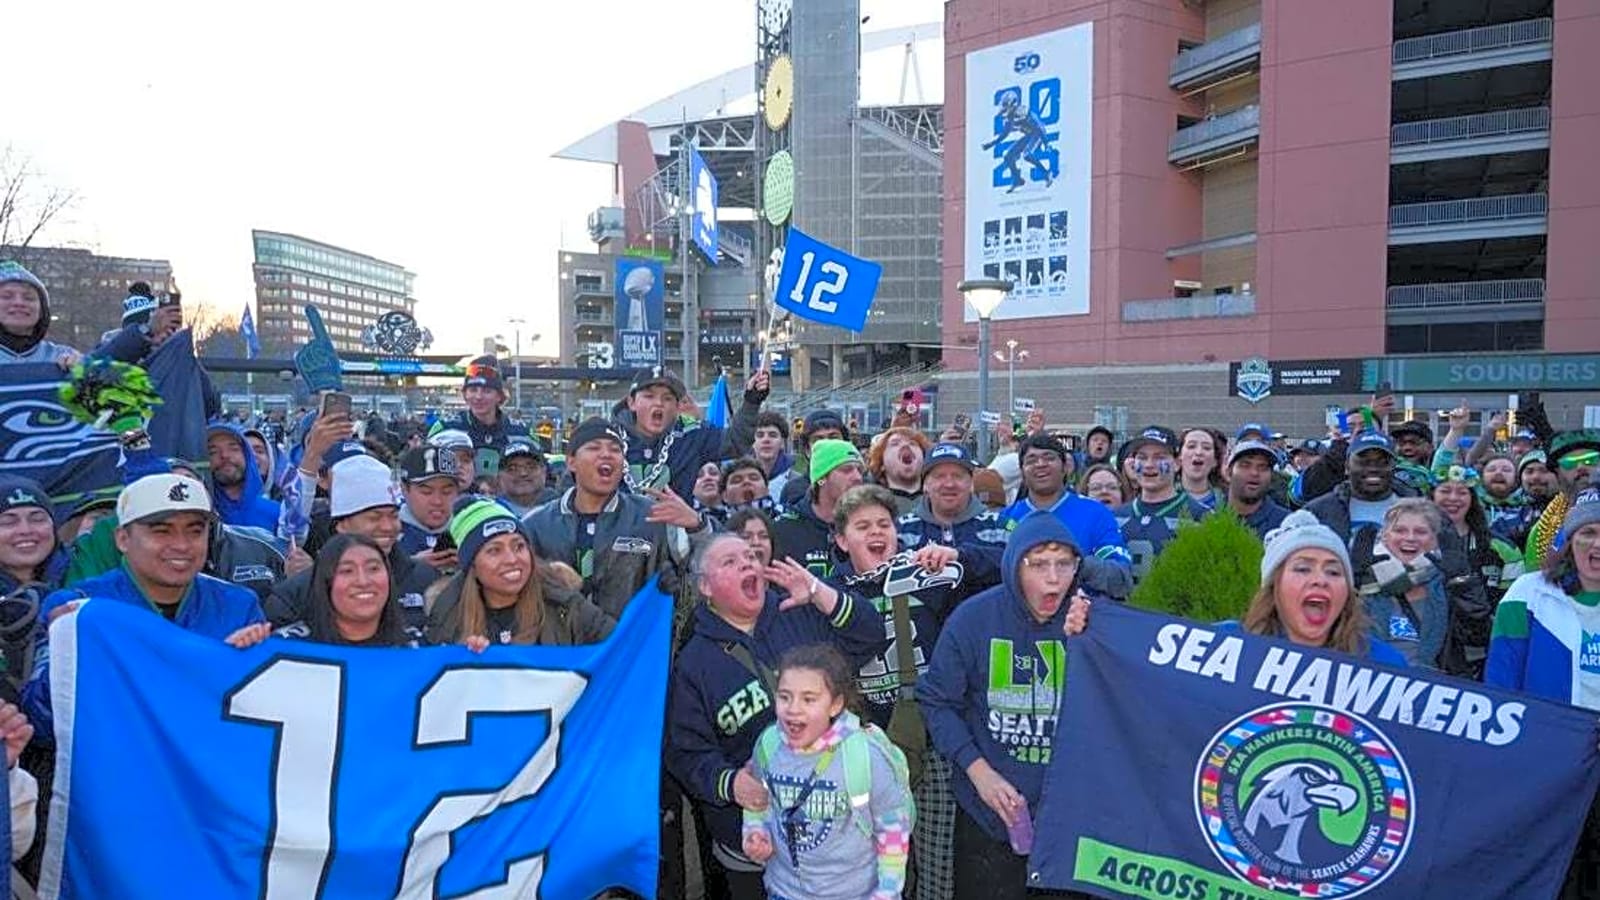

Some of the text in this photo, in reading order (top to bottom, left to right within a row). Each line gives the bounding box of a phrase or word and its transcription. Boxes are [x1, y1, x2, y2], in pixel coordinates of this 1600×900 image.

[1014, 53, 1041, 72] 50
[790, 251, 848, 314] 12
[641, 335, 657, 352] LX
[1449, 362, 1597, 382] SOUNDERS
[716, 680, 772, 737] SEA
[1148, 623, 1527, 746] SEA HAWKERS
[222, 654, 591, 900] 12
[1228, 728, 1386, 812] SEA HAWKERS LATIN AMERICA
[1097, 856, 1210, 900] ACROSS
[1311, 861, 1349, 879] SEATTLE
[1345, 824, 1380, 867] SEAHAWKS
